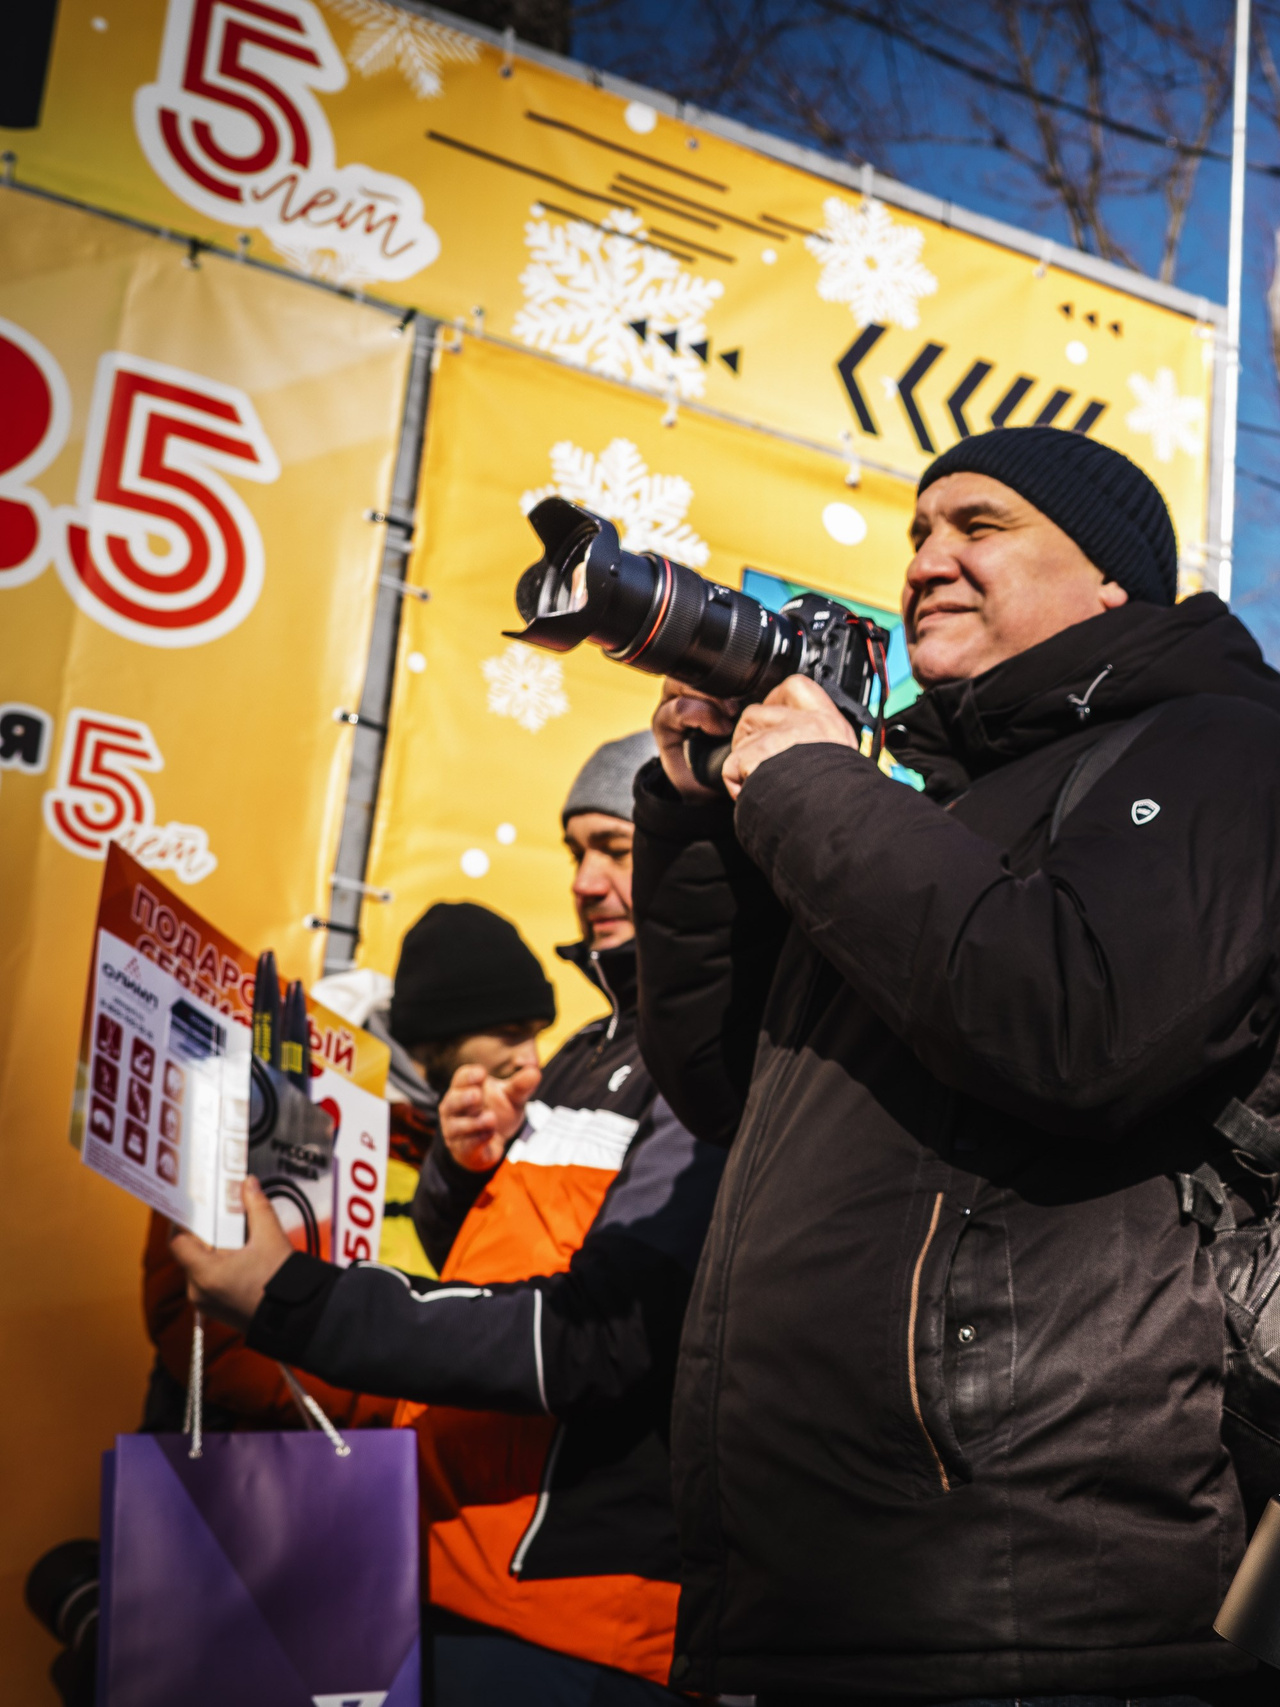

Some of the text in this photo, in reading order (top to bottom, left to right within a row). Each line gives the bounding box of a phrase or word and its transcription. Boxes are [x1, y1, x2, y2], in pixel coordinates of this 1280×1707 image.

[150, 0, 336, 210] 5
[252, 174, 416, 260] лет
[51, 716, 154, 852] 5
[131, 883, 357, 1078] ПОДАРОЫЙ
